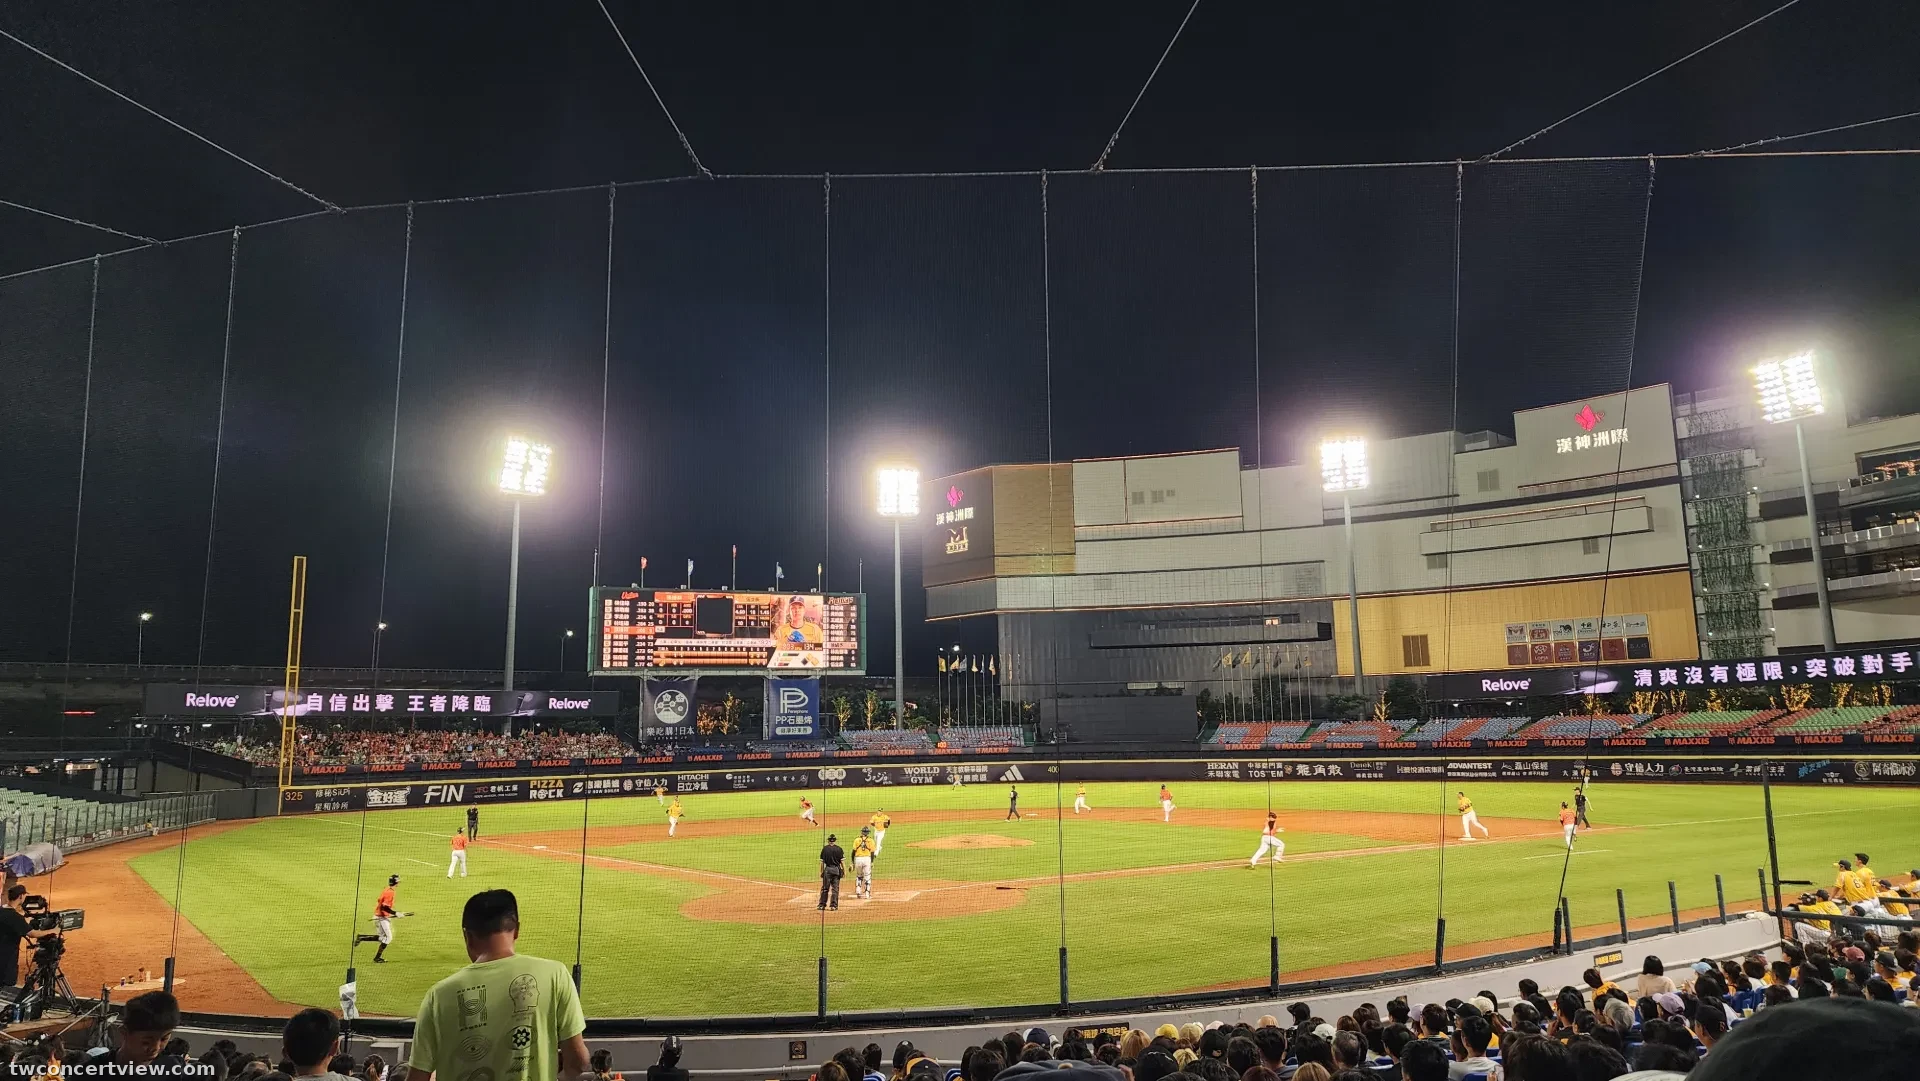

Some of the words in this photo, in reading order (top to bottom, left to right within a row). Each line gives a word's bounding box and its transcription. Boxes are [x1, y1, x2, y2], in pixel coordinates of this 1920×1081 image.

[1556, 428, 1628, 454] 漢神洲際
[936, 507, 974, 526] 漢神洲際
[1633, 651, 1914, 687] 清爽沒有極限，突破對手
[1481, 677, 1526, 693] Relove
[185, 692, 237, 707] Relove
[307, 693, 394, 712] 自信出擊
[407, 694, 491, 712] 王者降臨
[548, 697, 587, 710] Relove
[1551, 739, 1586, 747] MAXXIS
[1611, 738, 1647, 746] MAXXIS
[1673, 737, 1710, 745] MAXXIS
[1737, 737, 1775, 745] MAXXIS
[1804, 736, 1844, 744] MAXXIS
[1873, 735, 1914, 743] MAXXIS
[1439, 741, 1472, 749] MAXXIS
[1494, 740, 1528, 748] MAXXIS
[742, 752, 772, 760] MAXXIS
[484, 760, 517, 768] MAXXIS
[538, 759, 571, 767] MAXXIS
[592, 757, 622, 765] MAXXIS
[311, 765, 346, 774] MAXXIS
[371, 764, 405, 772] MAXXIS
[428, 762, 462, 770] MAXXIS
[1296, 764, 1344, 776] 龍角散
[1625, 763, 1664, 772] 守信人力
[903, 767, 940, 775] WORLD
[1207, 770, 1240, 779] 禾聯家電
[530, 779, 564, 789] PIZZA
[635, 778, 668, 787] 守信人力
[910, 776, 933, 784] GYM
[677, 781, 709, 791] 日立冷氣
[284, 791, 304, 801] 325
[367, 789, 408, 806] 金好運
[423, 784, 465, 804] FIN
[529, 788, 564, 800] ROCK
